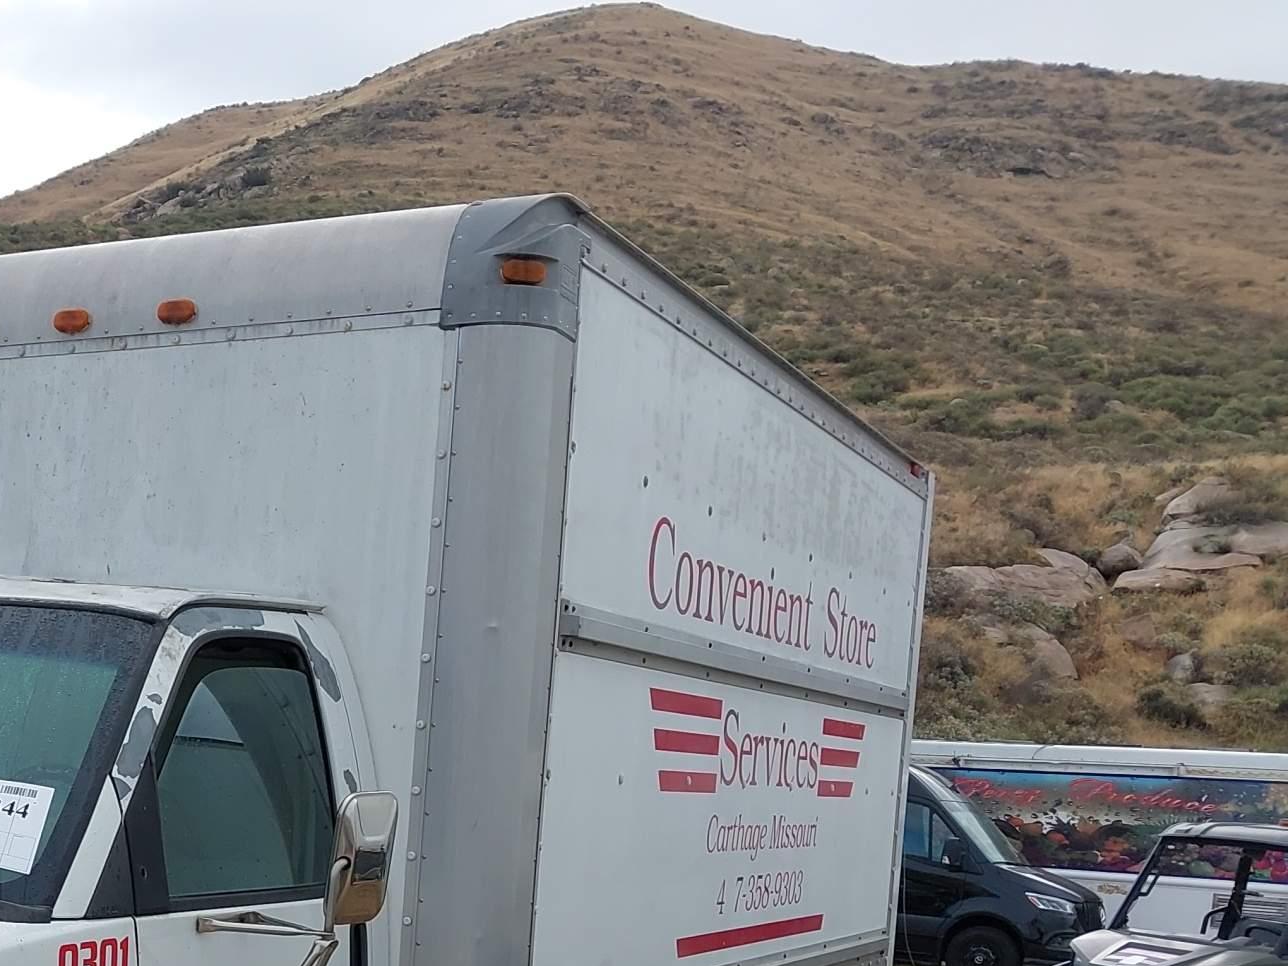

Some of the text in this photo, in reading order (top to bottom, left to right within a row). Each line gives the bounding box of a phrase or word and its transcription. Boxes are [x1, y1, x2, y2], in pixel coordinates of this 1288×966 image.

[649, 517, 876, 669] Convenient Store
[720, 709, 819, 791] Services
[707, 814, 818, 861] Carthage Missouri
